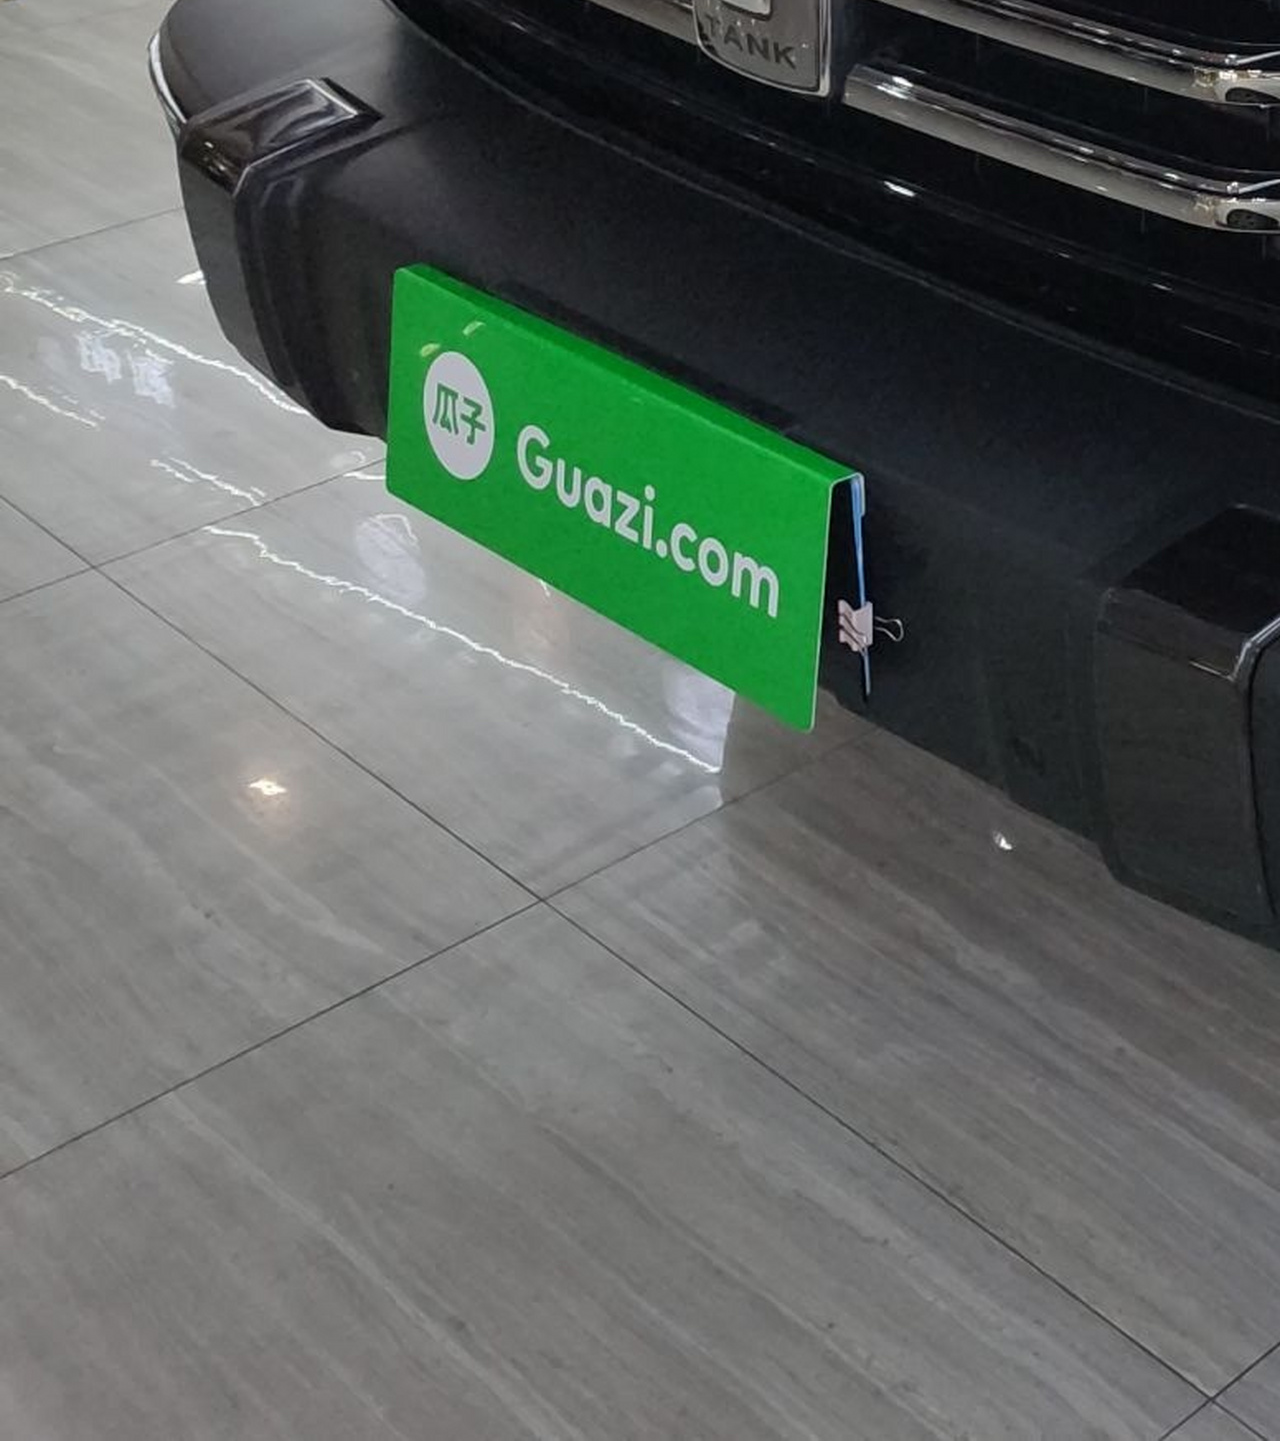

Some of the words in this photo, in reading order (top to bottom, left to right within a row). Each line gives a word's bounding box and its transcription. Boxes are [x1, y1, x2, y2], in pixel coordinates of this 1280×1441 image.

[704, 12, 798, 70] TANK
[432, 382, 487, 446] 瓜子
[516, 424, 780, 618] Guazi.com
